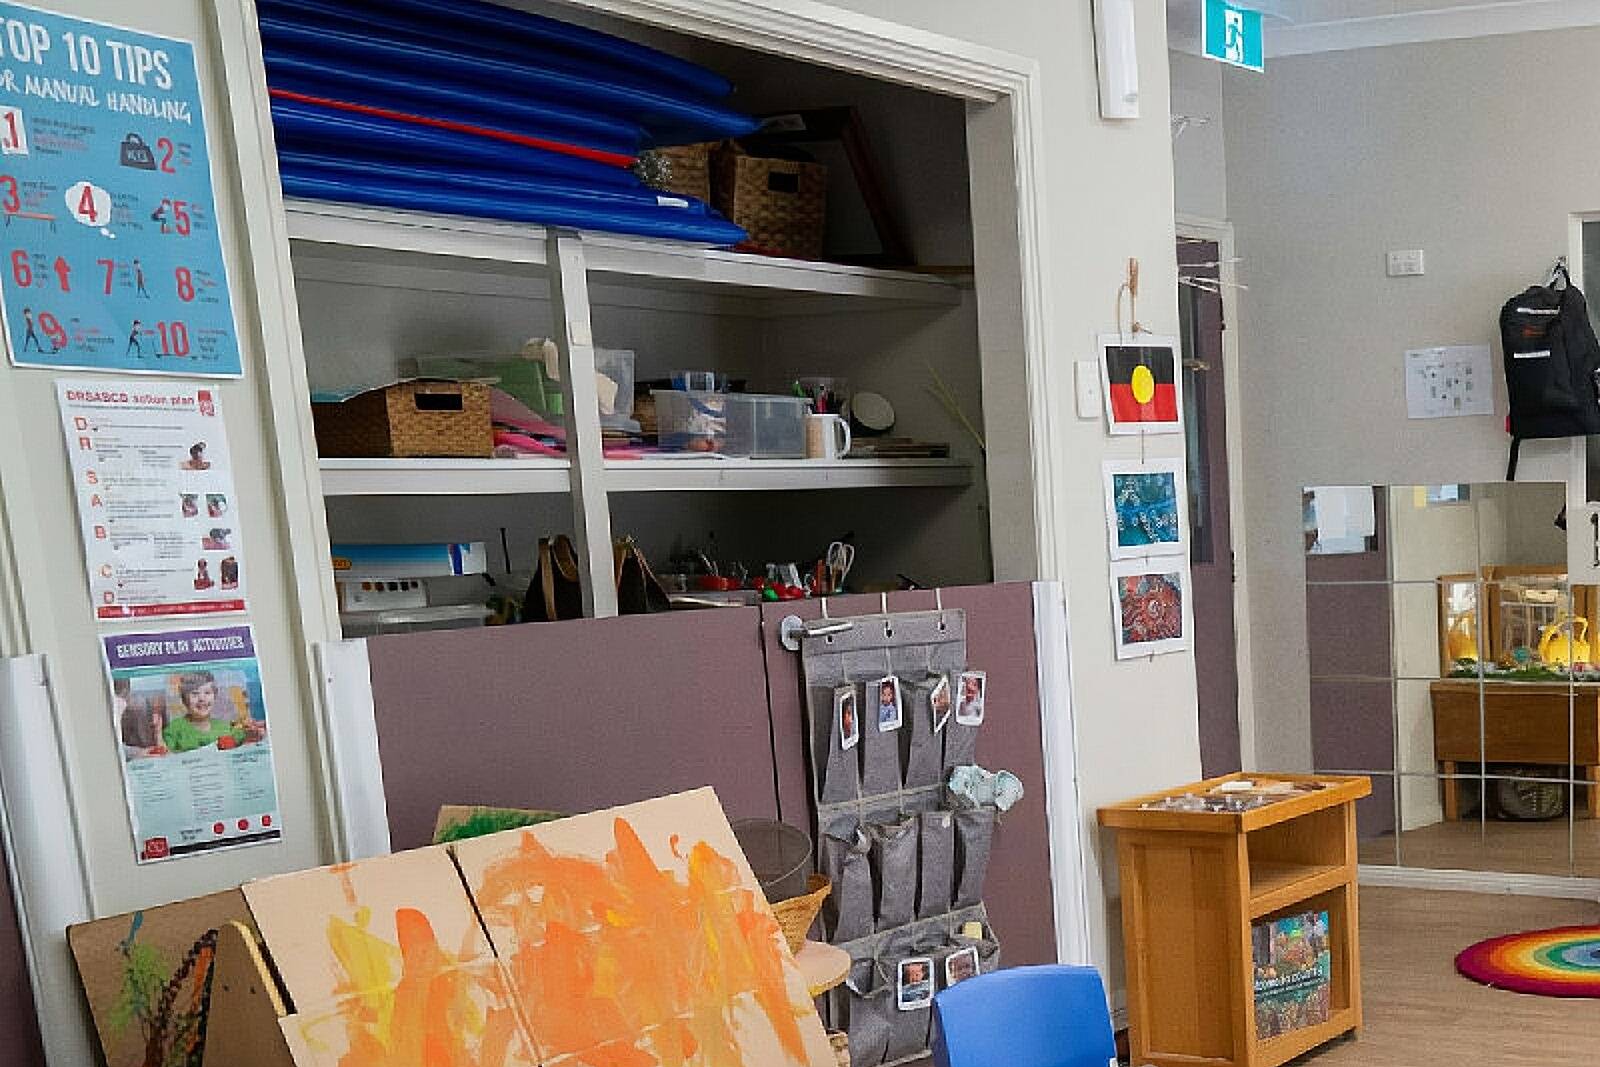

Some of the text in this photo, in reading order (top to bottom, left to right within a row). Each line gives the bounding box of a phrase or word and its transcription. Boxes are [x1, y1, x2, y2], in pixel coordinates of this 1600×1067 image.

[62, 31, 101, 75] 10
[106, 40, 172, 91] TIPS
[25, 74, 100, 107] MANUAL
[106, 92, 192, 126] HANDLING
[4, 111, 19, 148] 1
[157, 137, 176, 174] 2
[0, 174, 20, 213] 3
[78, 185, 97, 223] 4
[173, 200, 191, 236] 5
[11, 249, 32, 288] 6
[97, 258, 114, 295] 7
[175, 266, 195, 302] 8
[38, 311, 68, 348] 9
[157, 321, 190, 357] 10
[170, 395, 195, 406] plan
[117, 642, 163, 659] SENSORY
[164, 641, 189, 655] PLAY
